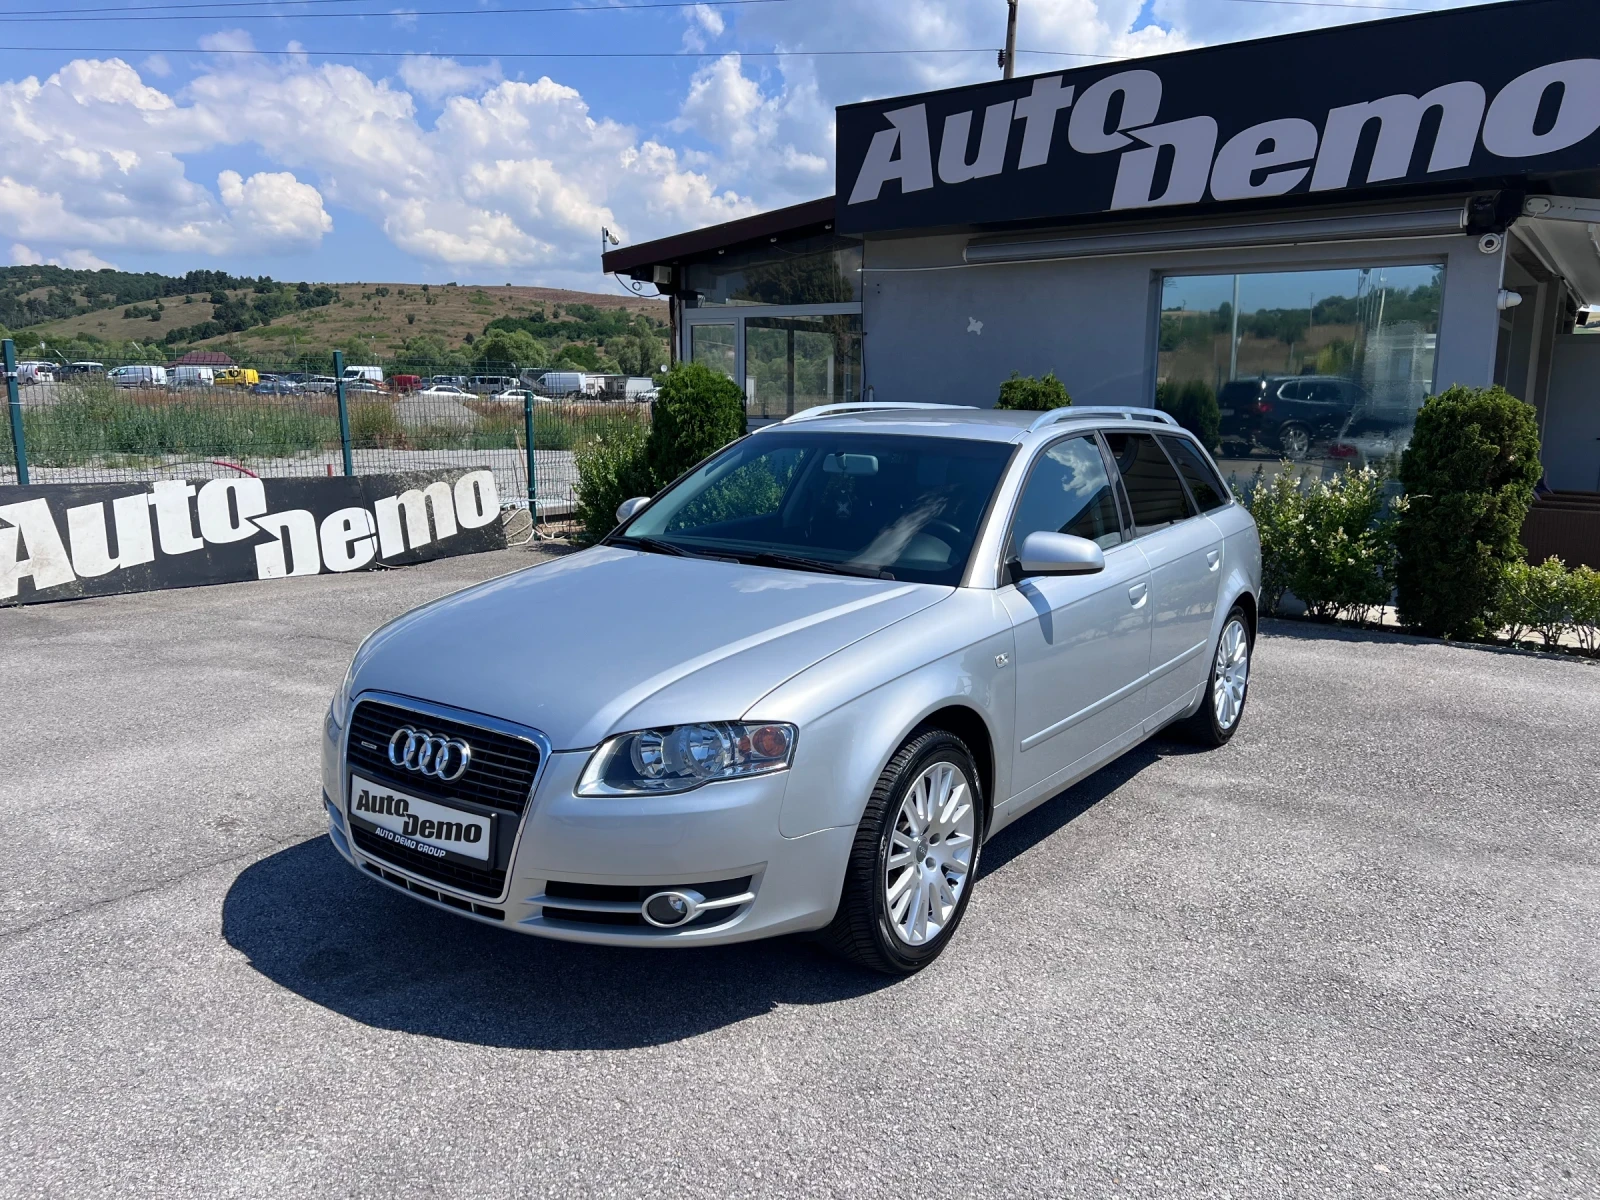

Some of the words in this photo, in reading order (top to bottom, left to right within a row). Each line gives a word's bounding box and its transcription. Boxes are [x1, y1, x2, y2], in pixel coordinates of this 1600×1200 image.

[848, 69, 1163, 206] Auto
[1110, 58, 1600, 211] Demo
[0, 478, 267, 599] Auto
[252, 469, 501, 580] Demo
[356, 790, 409, 817] Auto
[403, 814, 482, 843] Demo
[375, 828, 394, 840] AUTO
[395, 836, 416, 849] DEMO
[418, 844, 446, 857] GROUP
